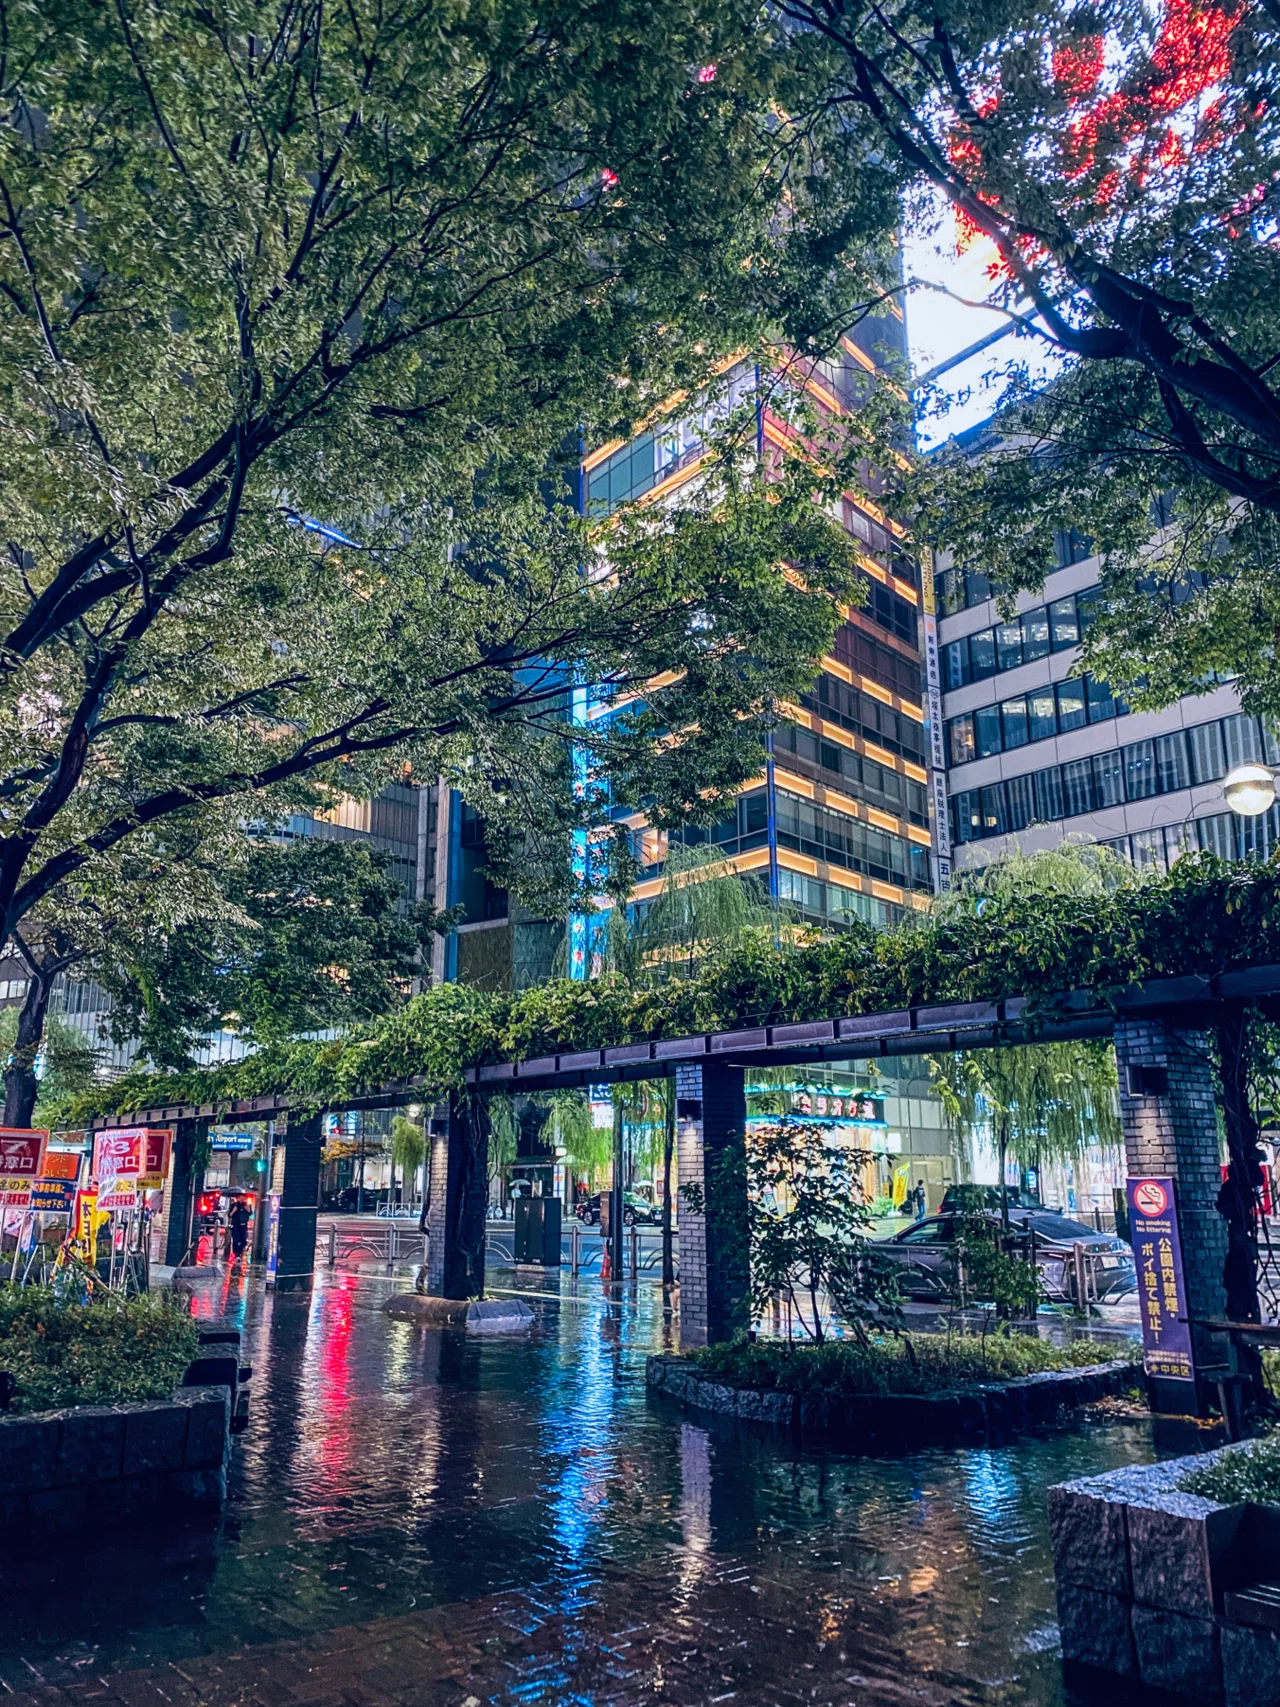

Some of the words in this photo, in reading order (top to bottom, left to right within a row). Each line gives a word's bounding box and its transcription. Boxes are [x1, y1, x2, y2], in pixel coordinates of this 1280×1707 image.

[1146, 1219, 1171, 1227] smoking
[1146, 1226, 1171, 1234] littering
[1161, 1364, 1190, 1376] 中央区
